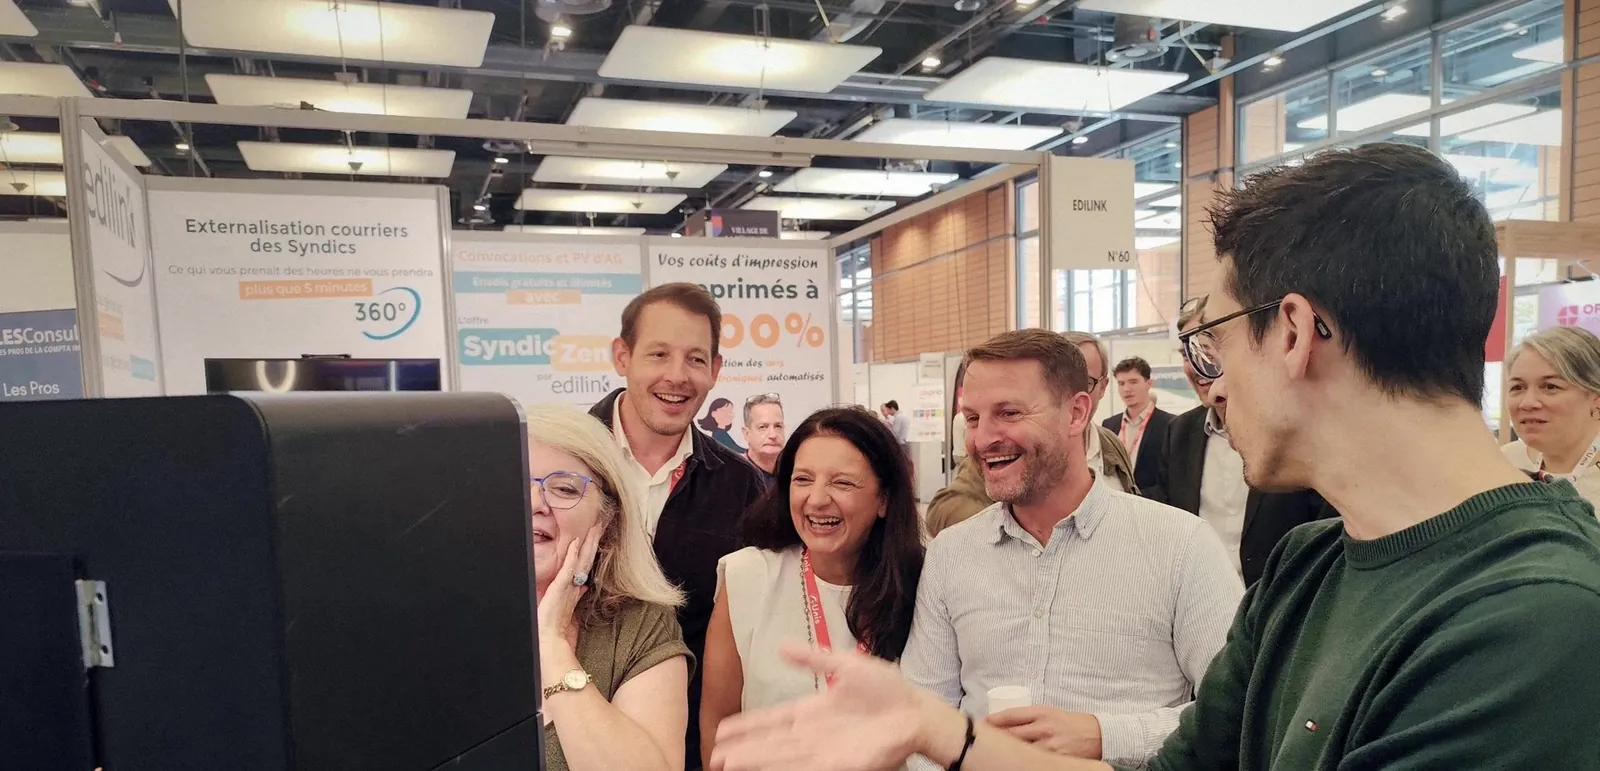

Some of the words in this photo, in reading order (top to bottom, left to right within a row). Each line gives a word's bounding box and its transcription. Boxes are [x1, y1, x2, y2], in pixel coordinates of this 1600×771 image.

[1072, 199, 1107, 212] EDILINK
[185, 218, 325, 236] Externalisation
[330, 222, 408, 238] courriers
[250, 238, 282, 252] des
[288, 239, 357, 256] Syndics
[458, 250, 551, 265] Convocations
[658, 253, 685, 267] Vos
[689, 253, 728, 268] coûts
[732, 254, 819, 271] d'impression
[168, 265, 184, 275] Ce
[187, 265, 206, 276] qui
[209, 266, 237, 275] vous
[240, 265, 280, 277] prenait
[283, 266, 304, 276] des
[306, 267, 344, 277] heures
[347, 269, 361, 277] ne
[364, 269, 389, 278] vous
[391, 268, 434, 279] prendra
[245, 283, 273, 297] plus
[276, 285, 302, 298] que
[315, 281, 368, 294] minutes
[525, 291, 561, 303] avec
[699, 276, 799, 301] primés
[806, 279, 819, 299] à
[464, 335, 557, 361] Syndic
[721, 358, 743, 368] tion
[767, 368, 825, 382] automatisés
[3, 382, 27, 397] Les
[29, 380, 60, 396] Pros
